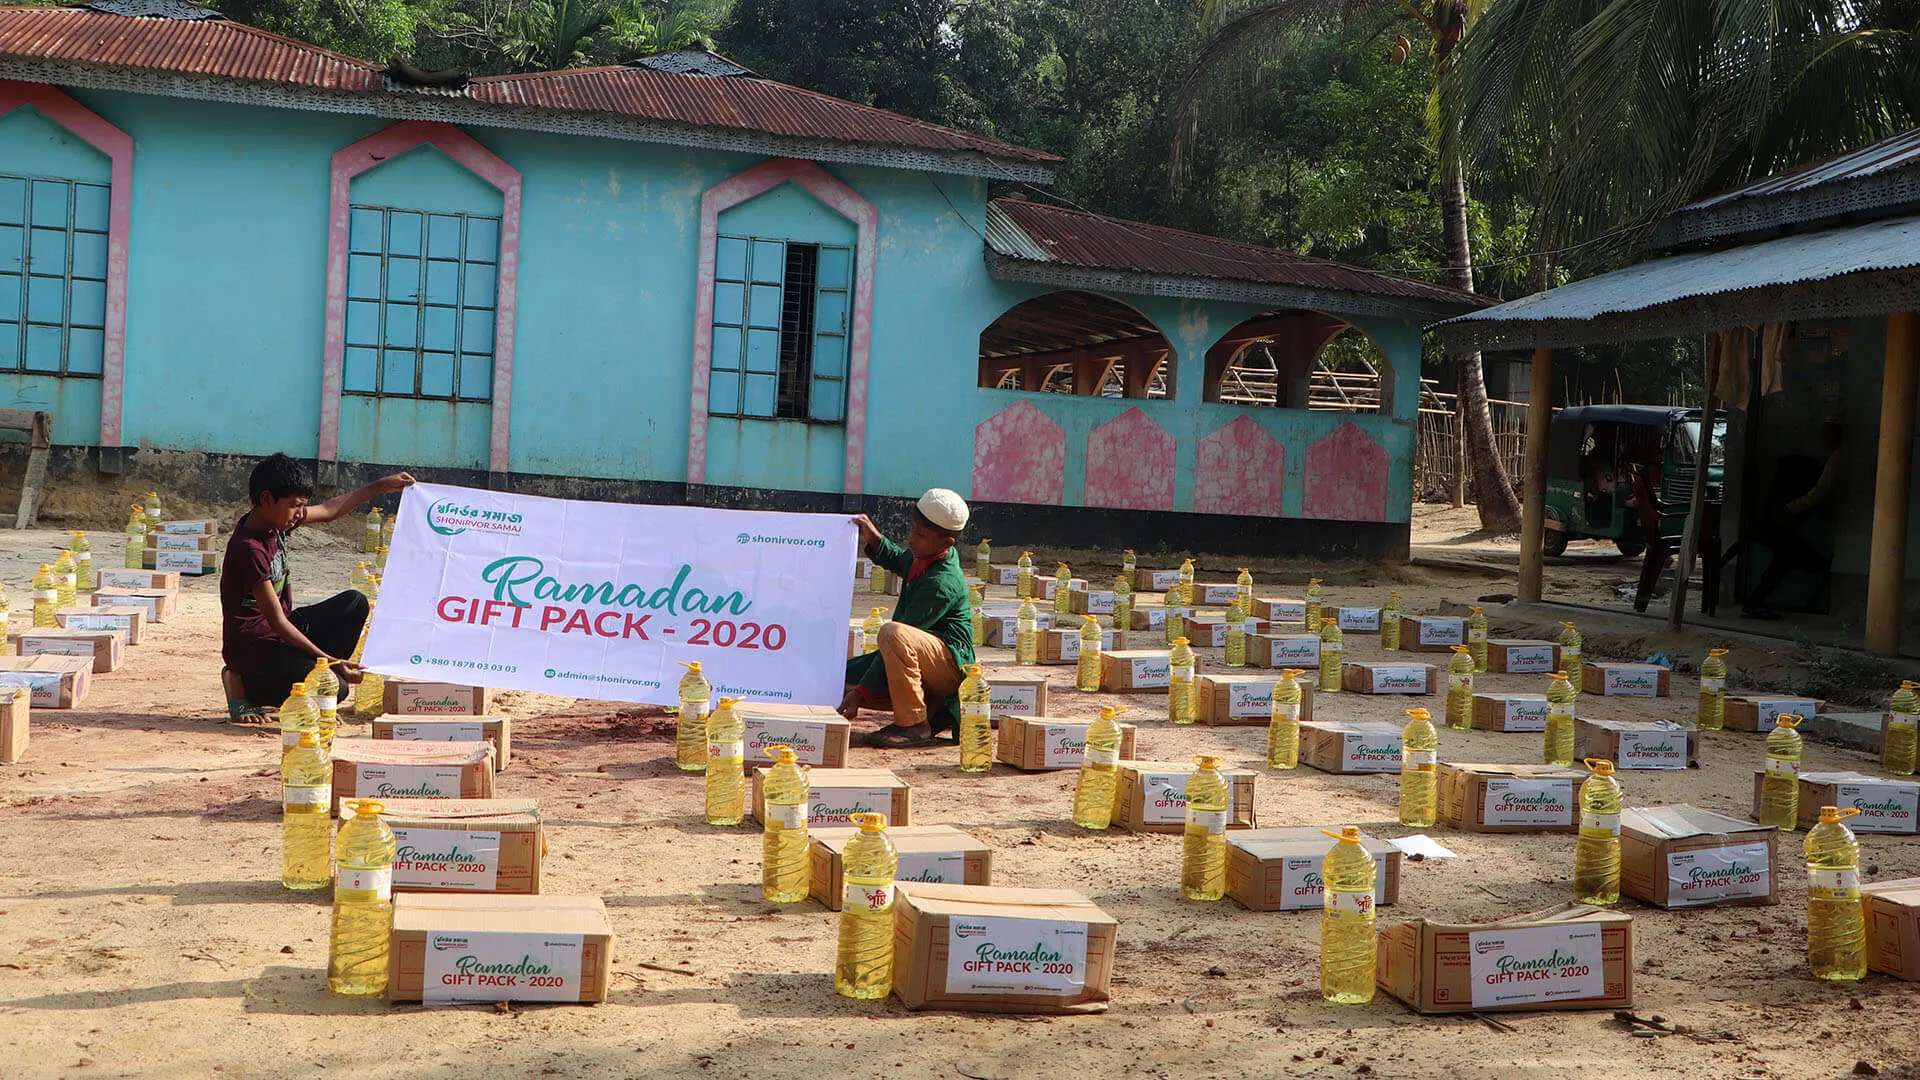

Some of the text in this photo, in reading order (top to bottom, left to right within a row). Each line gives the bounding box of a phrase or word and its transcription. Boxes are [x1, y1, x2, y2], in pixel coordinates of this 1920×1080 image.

[481, 509, 523, 524] সমাজ
[435, 515, 490, 529] SHONIRVOR
[491, 523, 522, 533] SAMAJ
[751, 535, 825, 549] shonirvor.org
[481, 556, 753, 616] Ramadan
[436, 595, 532, 629] GIFT
[539, 605, 652, 640] PACK
[686, 618, 787, 651] 2020
[426, 658, 517, 673] +880 1878 03 03 03
[557, 671, 661, 689] admin@shonirvor.org
[716, 685, 792, 700] shonirvor.samaj
[1242, 692, 1272, 703] Ramad
[413, 696, 459, 707] Ramadan
[990, 695, 1023, 705] amadan
[757, 731, 808, 744] Ramadan
[750, 741, 767, 750] GIFT
[796, 744, 816, 752] 2020
[1053, 747, 1085, 755] GIFT PAC
[1357, 743, 1400, 755] Ramadan
[1633, 742, 1673, 752] Ramadan
[1351, 753, 1366, 761] GIFT
[377, 782, 441, 798] Ramadan
[1155, 800, 1186, 808] GIFT PA
[1502, 792, 1557, 805] Ramadan
[1853, 798, 1903, 811] Ramadan
[812, 801, 872, 817] Ramadan
[1494, 804, 1514, 812] GIFT
[1515, 804, 1538, 812] PACK
[827, 815, 850, 824] PACK
[396, 845, 476, 863] Ramadan
[393, 861, 413, 870] IFT
[415, 862, 447, 872] PACK
[458, 863, 486, 873] 2020
[1688, 861, 1751, 881] Ramadan
[1681, 880, 1703, 890] GIFT
[1705, 877, 1731, 888] PACK
[1739, 873, 1760, 883] 2020
[1294, 886, 1316, 896] GIFT
[976, 942, 1062, 963] Ramadan
[455, 955, 551, 977] Ramadan
[963, 961, 993, 972] GIFT
[996, 962, 1032, 973] PACK
[1042, 963, 1073, 974] 2020
[1496, 949, 1578, 975] Ramadan
[441, 974, 475, 985] GIFT
[478, 975, 517, 987] PACK
[529, 976, 564, 988] 2020
[1486, 973, 1513, 984] GIFT
[1517, 969, 1550, 982] PACK
[1560, 965, 1589, 978] 2020
